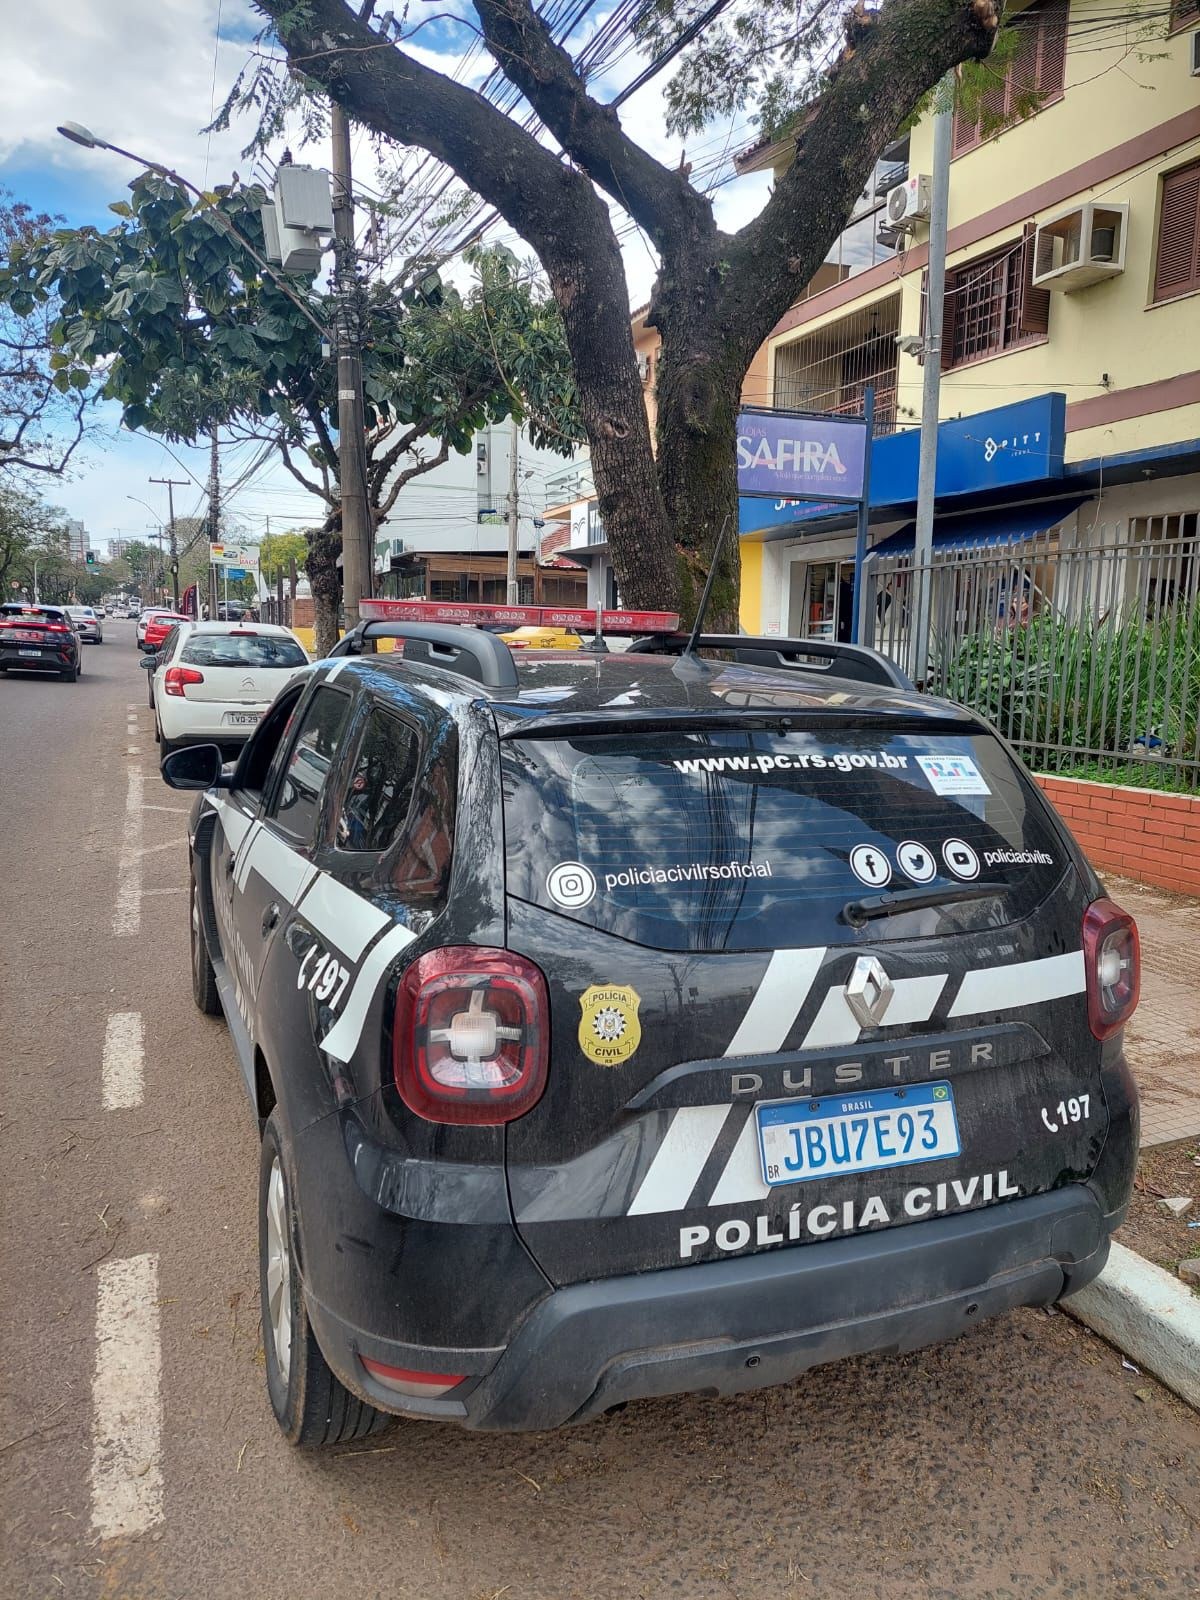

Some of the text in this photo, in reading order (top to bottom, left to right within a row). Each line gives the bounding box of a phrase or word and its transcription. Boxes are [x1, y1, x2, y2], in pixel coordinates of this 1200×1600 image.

[1002, 432, 1040, 448] PITT
[737, 436, 847, 474] SAFIRA
[673, 754, 908, 776] www.pc.rs.gov.br
[983, 848, 1053, 867] policiacivilrs
[605, 861, 772, 891] policiacivilrsoficial
[307, 952, 350, 1010] 197
[593, 991, 627, 1002] POLÍCIA
[594, 1048, 623, 1056] CIVIL
[731, 1042, 993, 1095] DUSTER
[841, 1100, 873, 1112] BRASIL
[1056, 1094, 1091, 1127] 197
[784, 1109, 938, 1171] JBU7E93
[768, 1164, 780, 1179] BR
[679, 1169, 1020, 1258] POLÍCIA CIVIL
